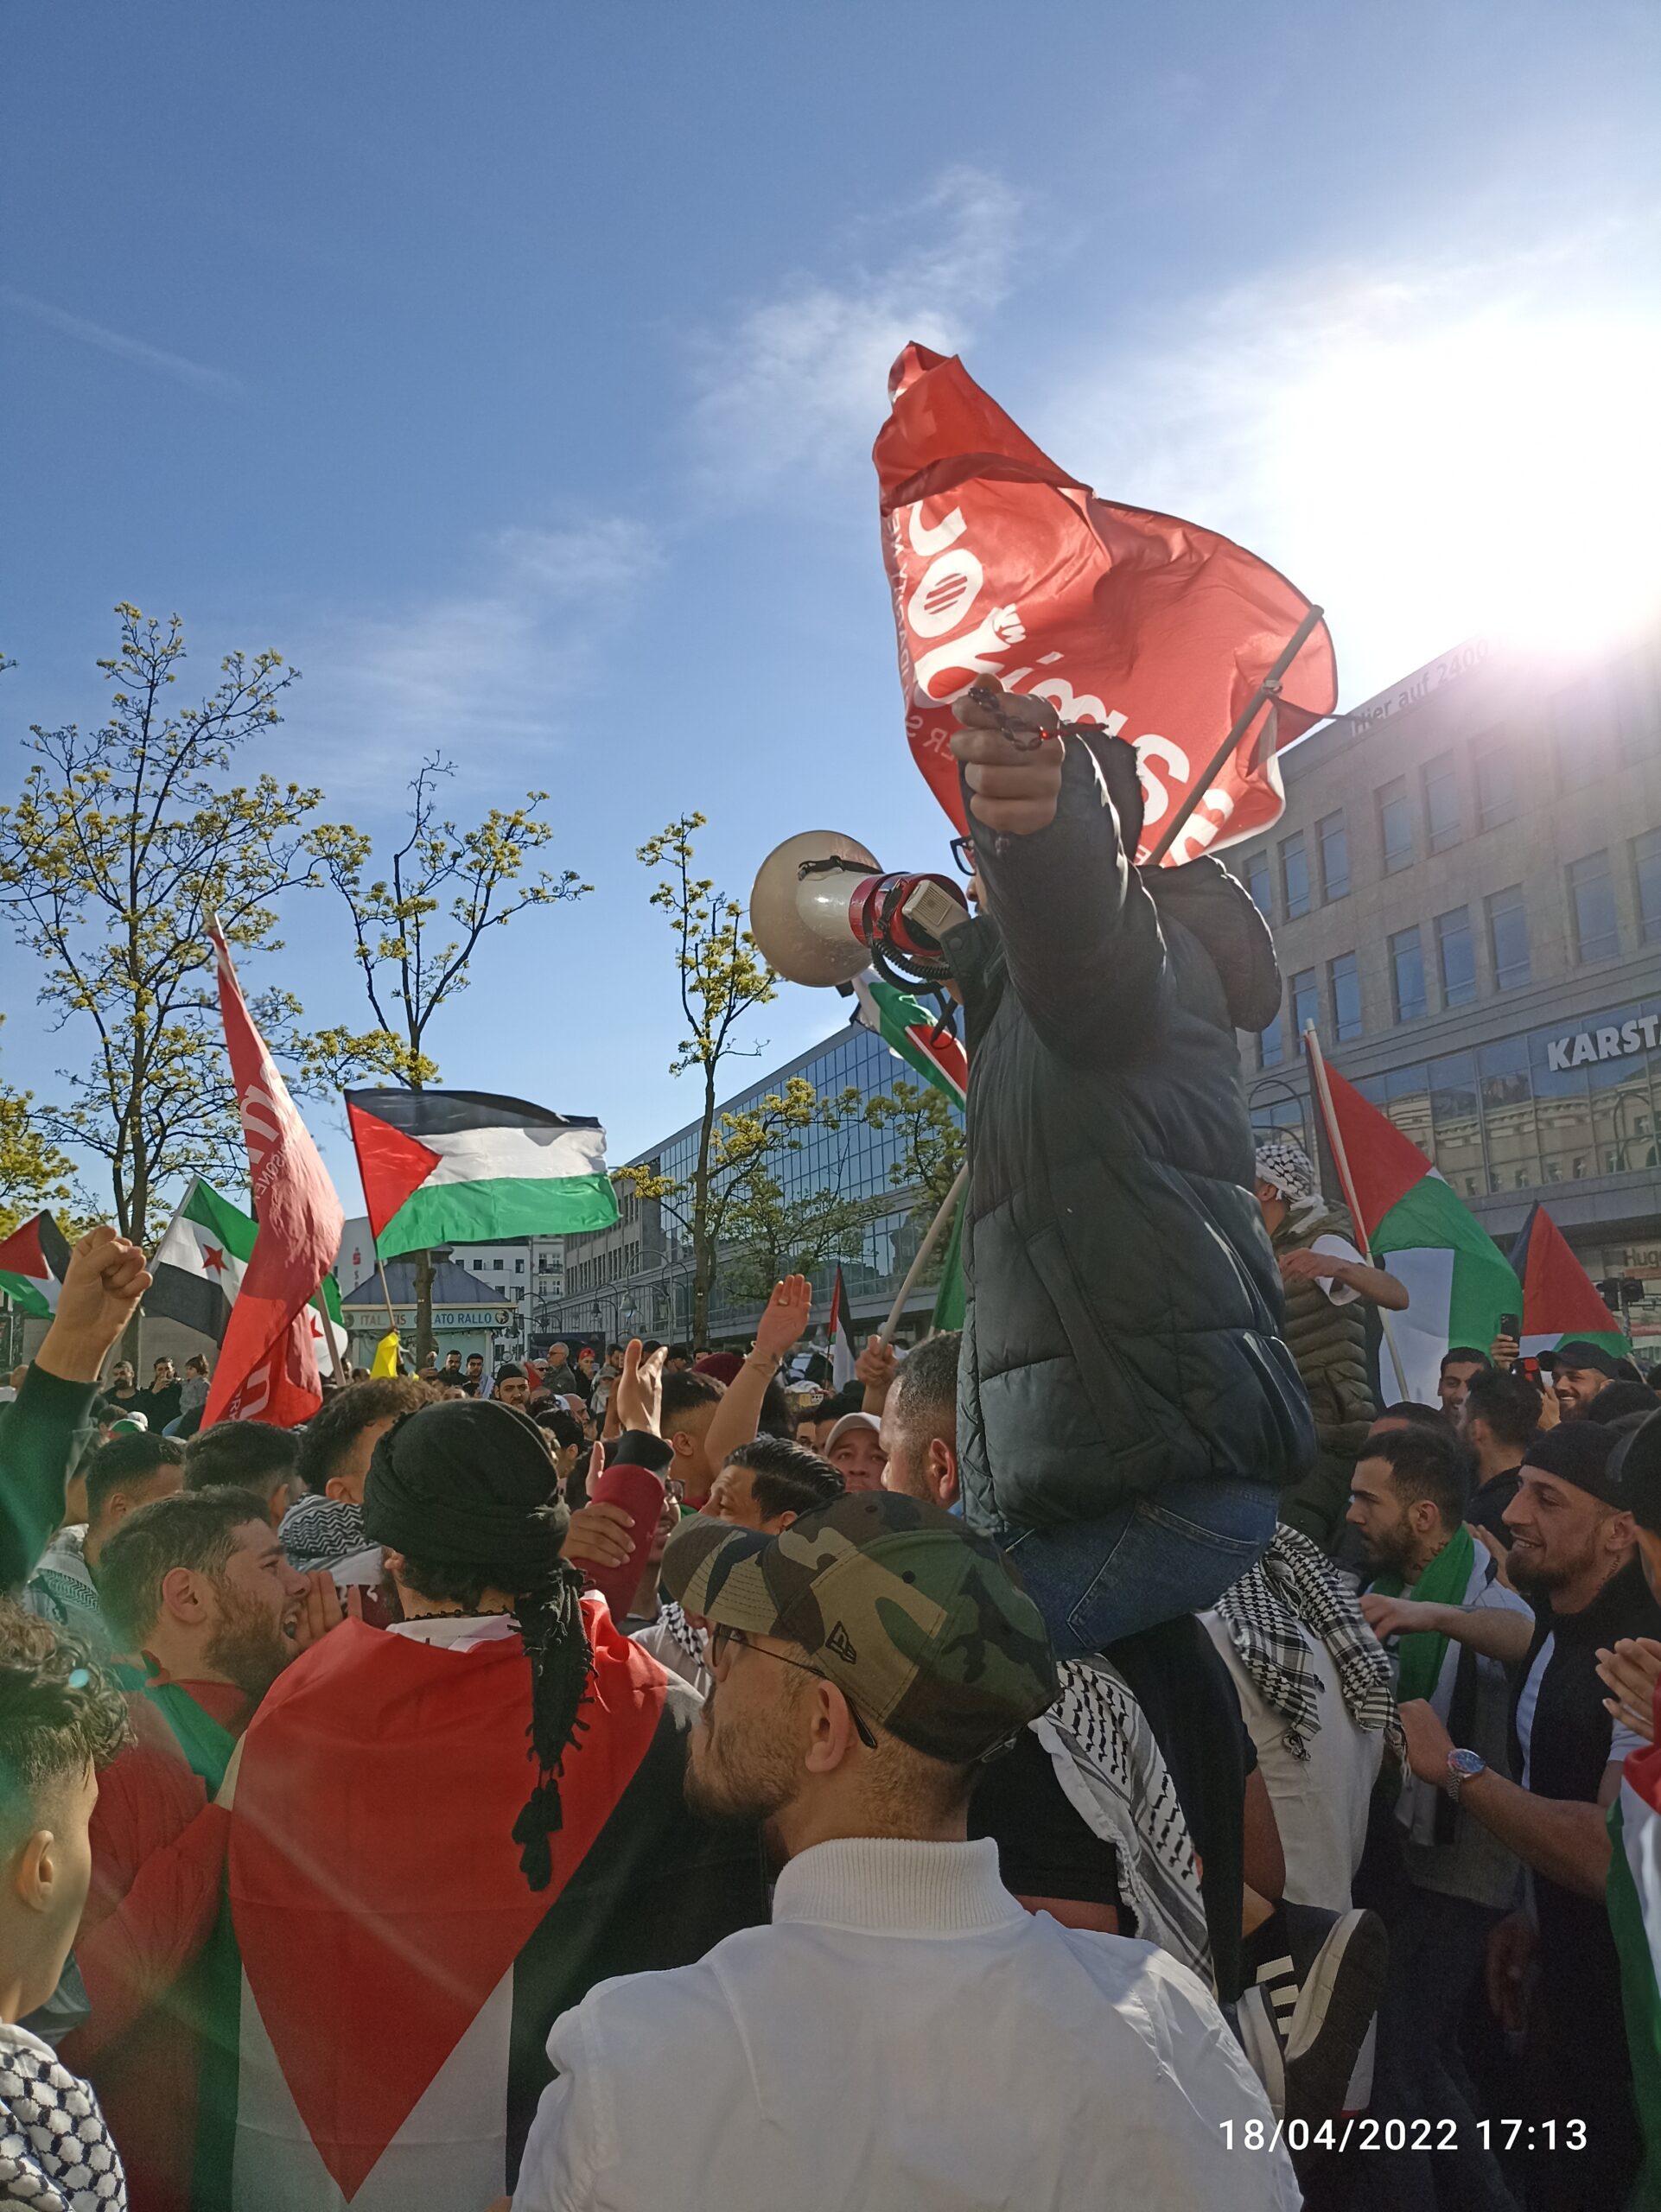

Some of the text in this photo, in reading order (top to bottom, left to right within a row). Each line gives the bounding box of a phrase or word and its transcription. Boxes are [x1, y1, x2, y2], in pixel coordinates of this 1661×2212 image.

[1398, 671, 1430, 710] auf
[1435, 638, 1490, 685] 2400
[1547, 1014, 1661, 1072] KARST
[1622, 1247, 1661, 1270] Hug
[458, 1312, 492, 1325] RALLO
